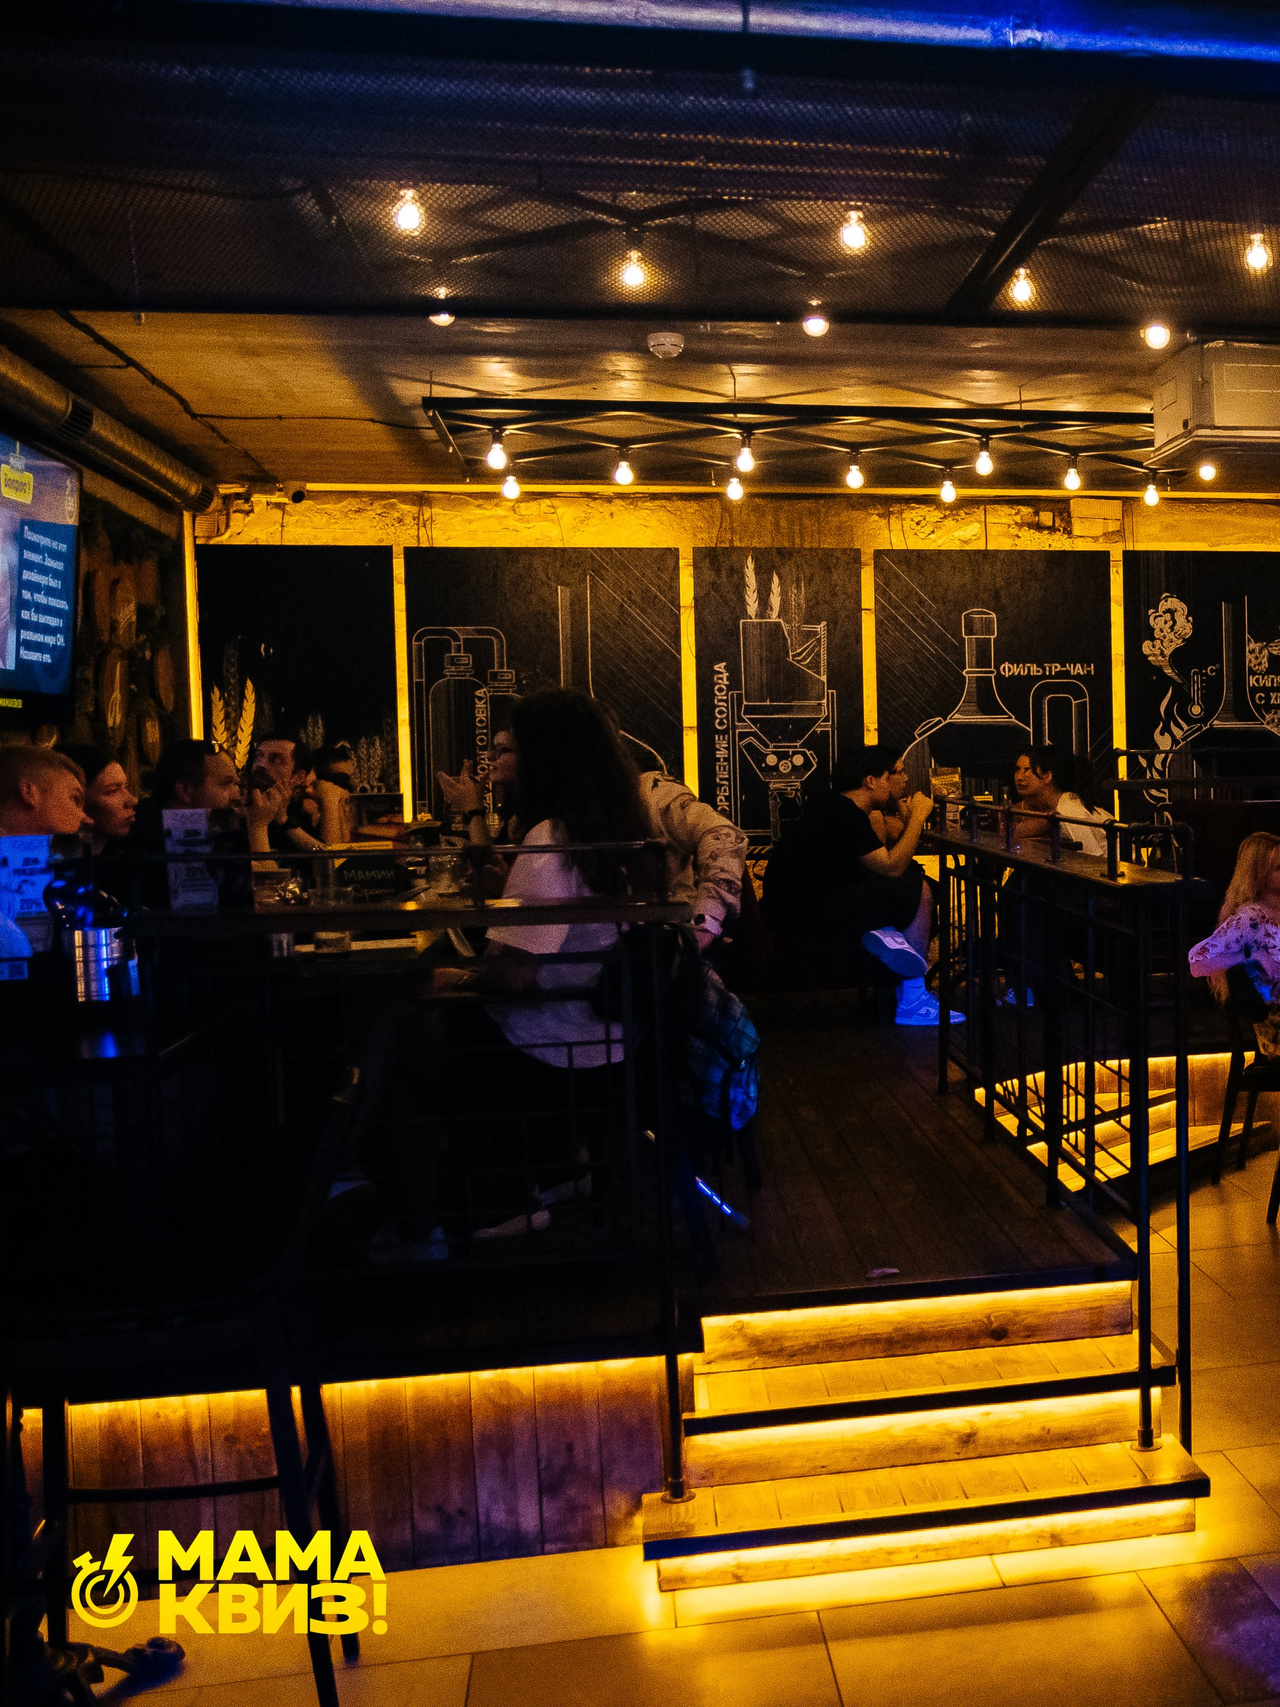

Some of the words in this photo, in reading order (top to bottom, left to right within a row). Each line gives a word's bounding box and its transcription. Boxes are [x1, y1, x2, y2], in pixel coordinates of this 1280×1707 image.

[1000, 661, 1095, 678] ФИЛЬТР-ЧАН
[713, 661, 729, 730] СОЛОДА
[1255, 692, 1266, 704] С
